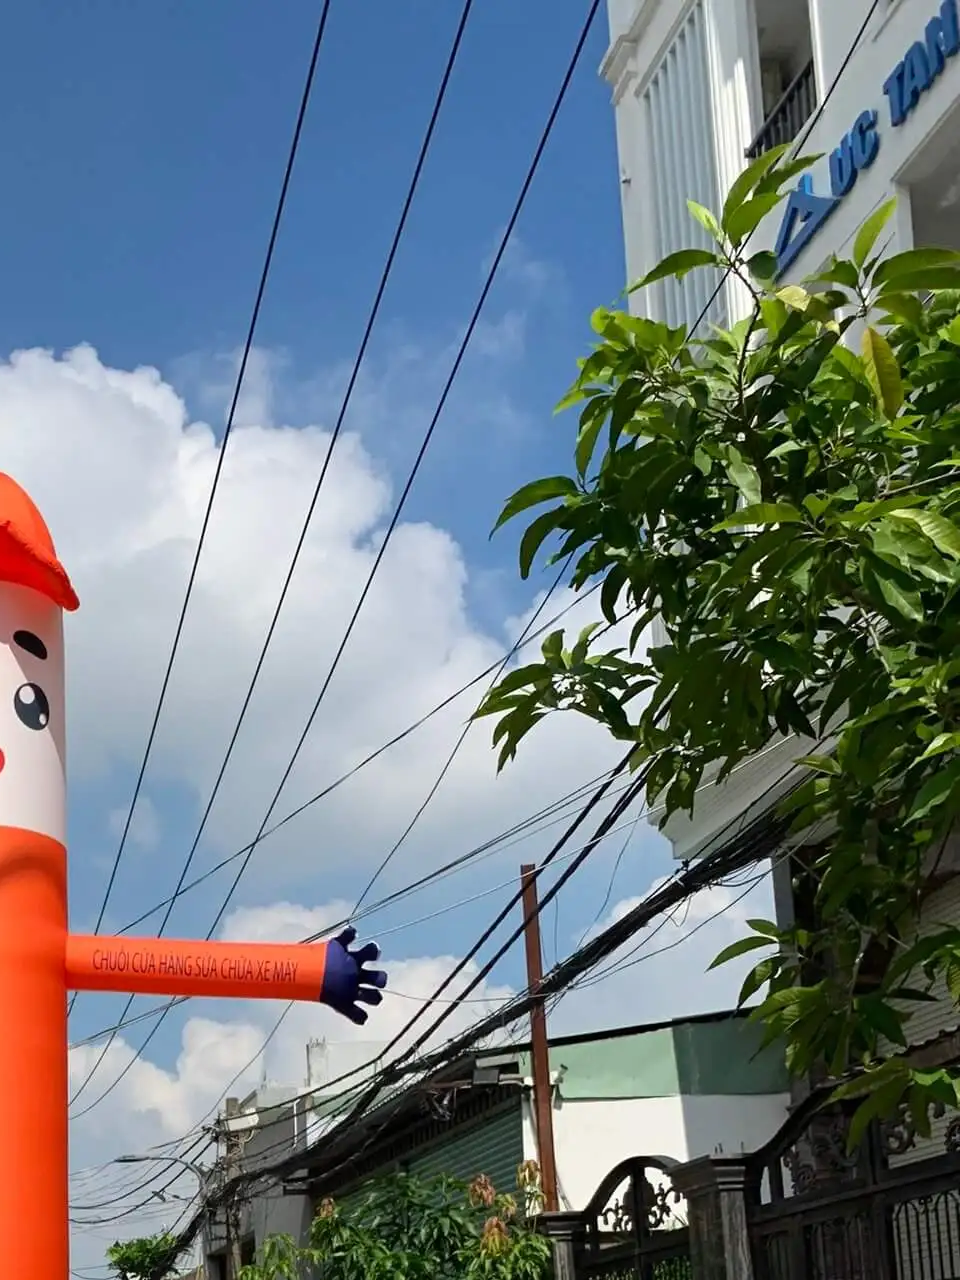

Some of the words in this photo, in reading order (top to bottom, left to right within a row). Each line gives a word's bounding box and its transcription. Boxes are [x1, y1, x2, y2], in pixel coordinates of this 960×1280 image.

[159, 951, 193, 977] HÀNG
[255, 960, 270, 982] XE
[273, 958, 298, 983] MÁY
